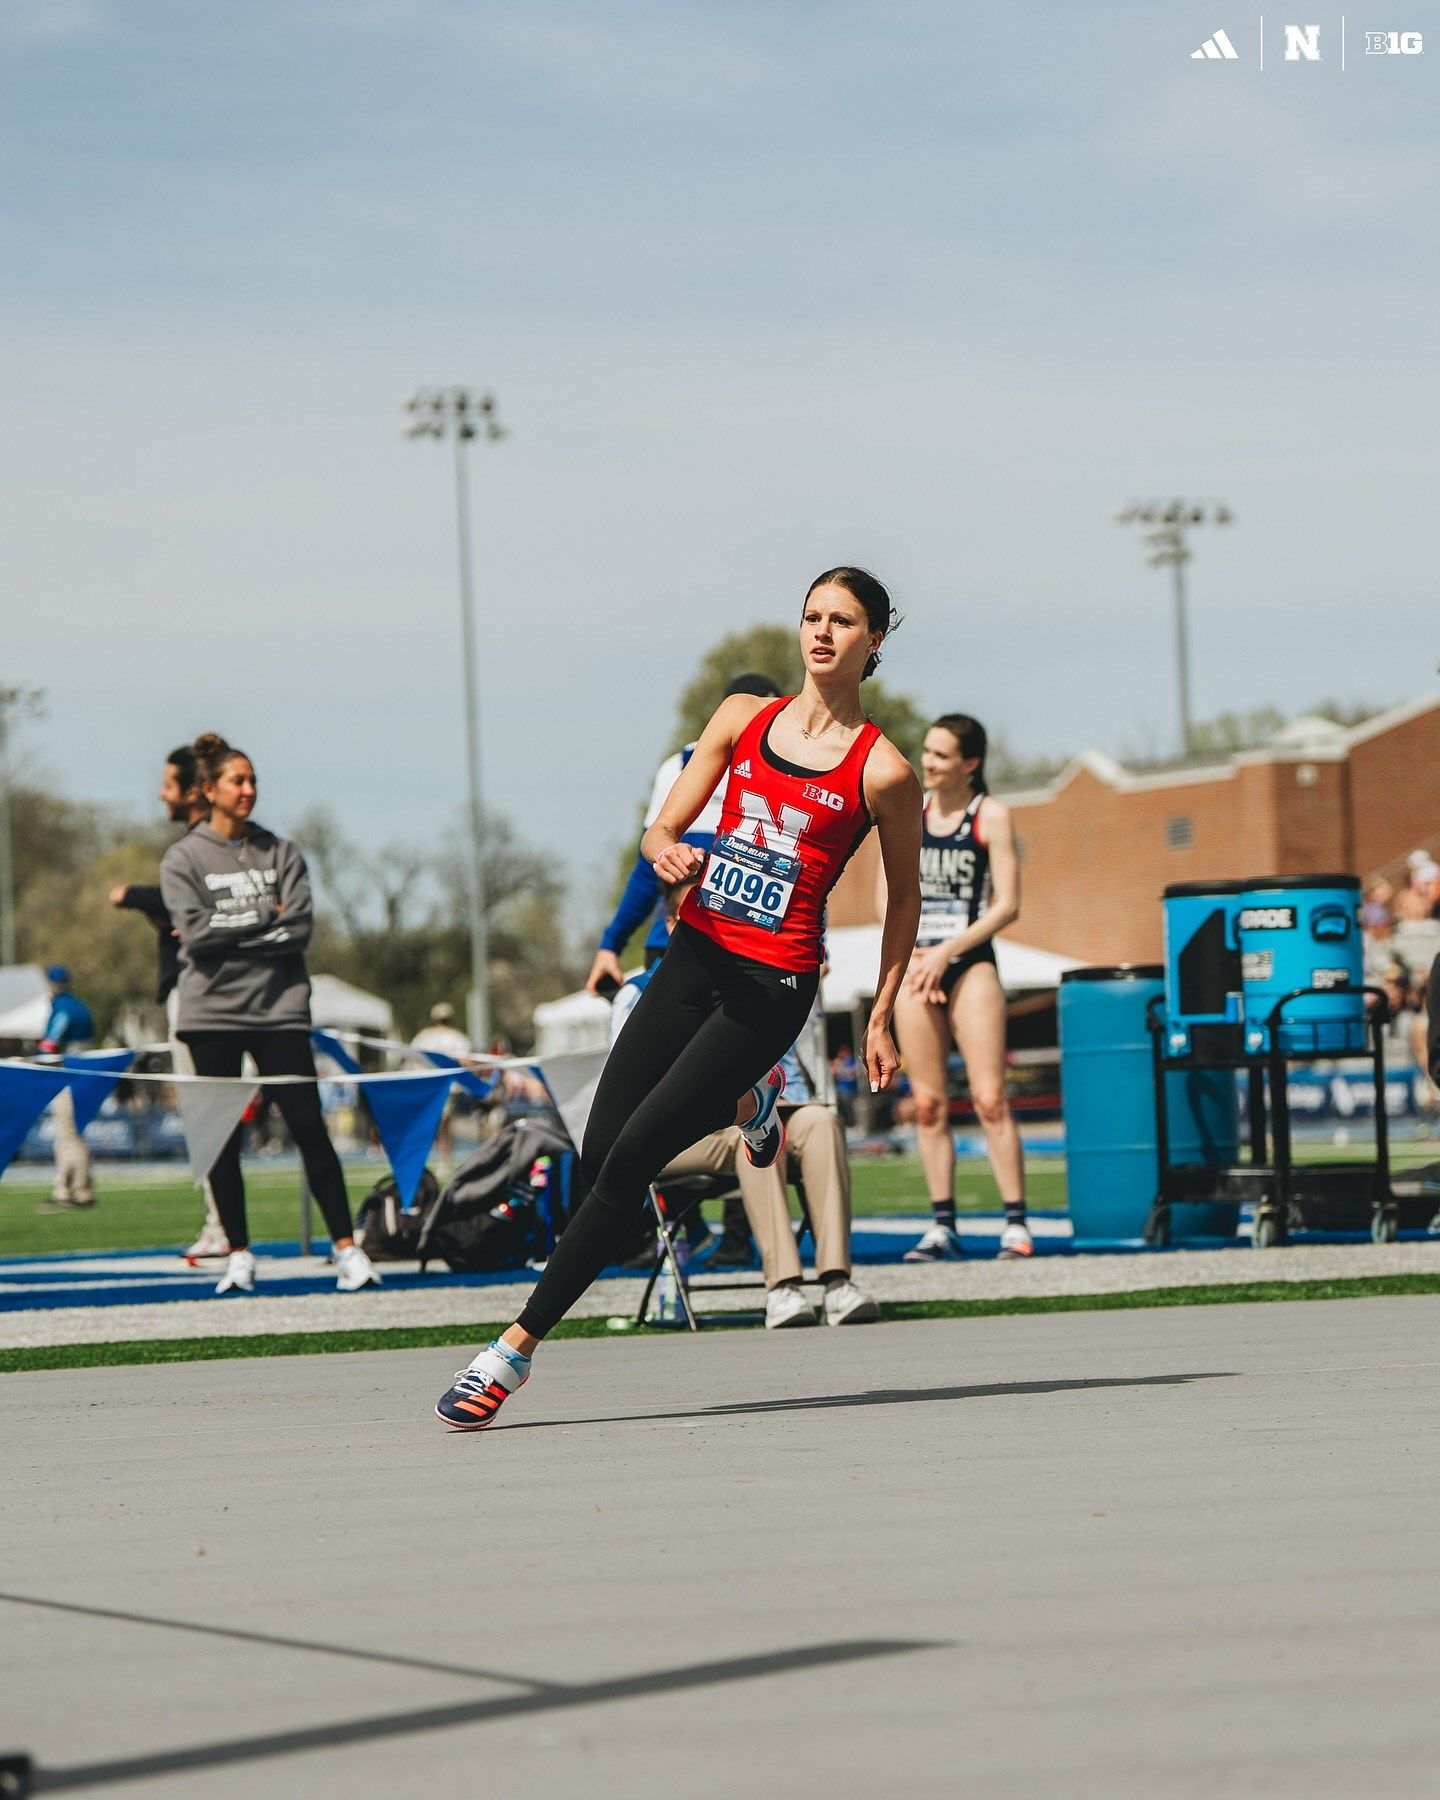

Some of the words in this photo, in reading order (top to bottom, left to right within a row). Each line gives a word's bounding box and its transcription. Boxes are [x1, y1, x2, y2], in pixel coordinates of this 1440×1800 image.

[732, 789, 814, 860] N
[747, 847, 770, 860] RELAYS
[709, 861, 784, 911] 4096
